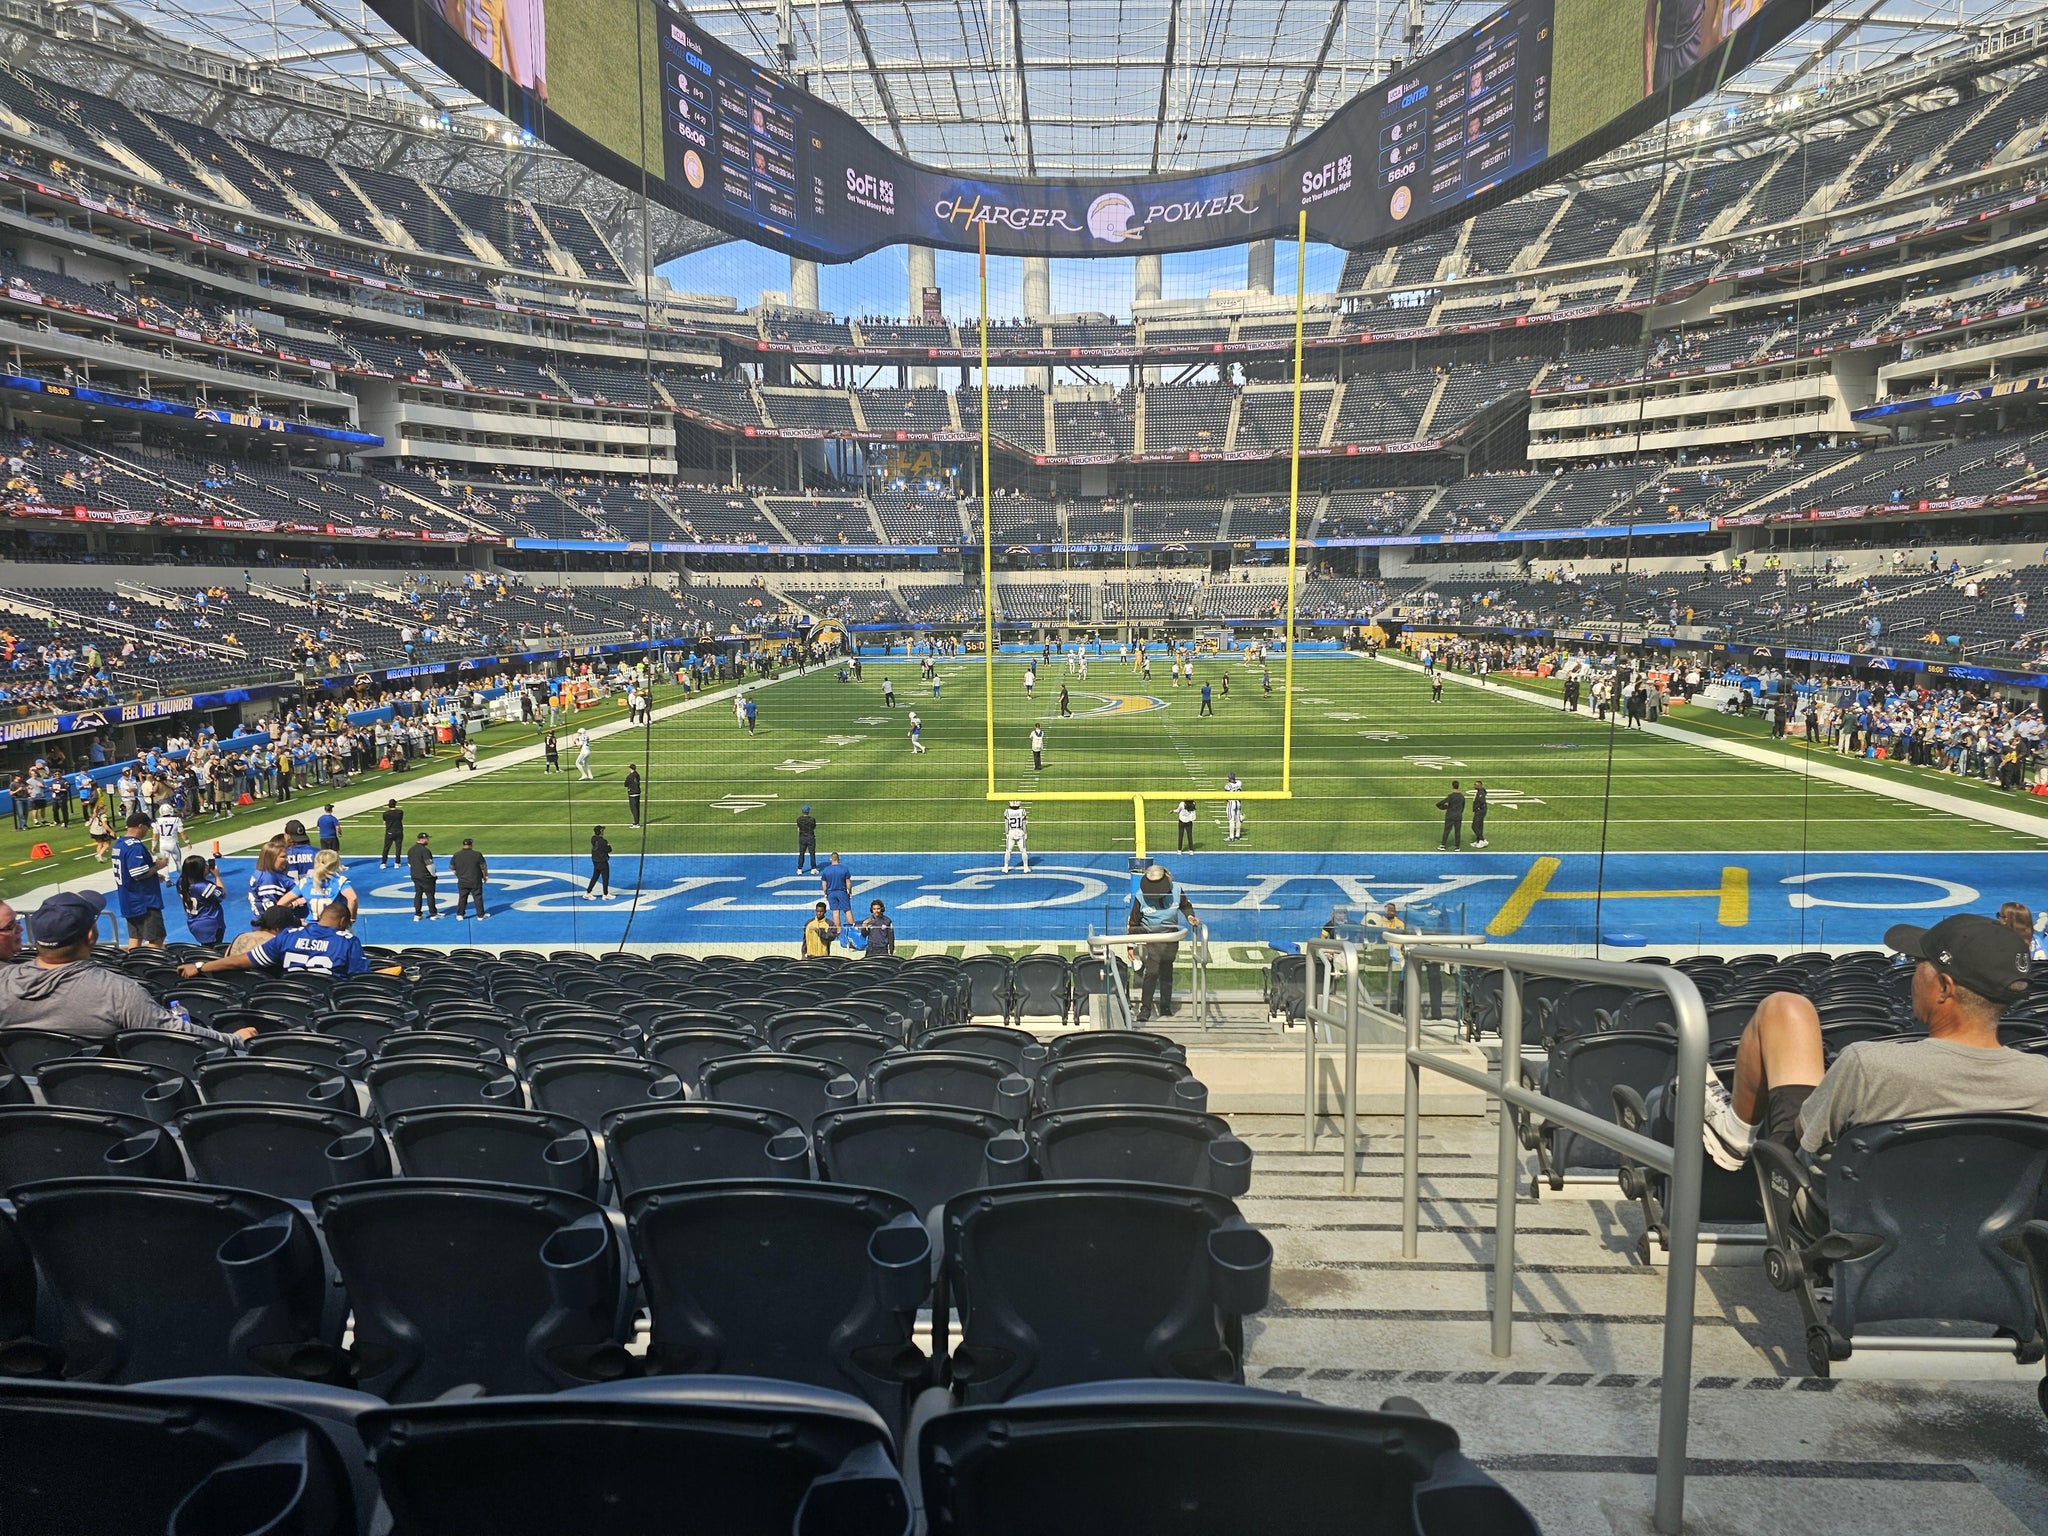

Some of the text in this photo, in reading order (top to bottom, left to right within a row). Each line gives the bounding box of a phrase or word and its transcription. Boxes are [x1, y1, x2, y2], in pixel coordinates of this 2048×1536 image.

[686, 52, 712, 76] CENTER
[1403, 78, 1419, 93] Health
[1401, 84, 1428, 108] CENTER
[846, 168, 877, 200] SoFi
[1302, 161, 1335, 194] SoFi
[1302, 196, 1312, 204] Get
[1312, 193, 1322, 201] Your
[1323, 187, 1338, 198] Money
[866, 200, 881, 212] Money
[934, 194, 1259, 232] CHARGER POWER
[2037, 377, 2048, 390] L
[230, 413, 285, 432] BOLT UP LA
[1389, 440, 1436, 452] TRUCKTOBER
[1072, 455, 1113, 465] TRUCKTOBER
[1785, 648, 1850, 664] WELCOME TO THE STORM
[387, 664, 445, 680] WELCOME TO THE STORM
[122, 697, 193, 720] FEEL THE THUNDER
[4, 718, 59, 742] LIGHTNING
[160, 824, 174, 836] 17
[1009, 817, 1022, 829] 21
[288, 854, 312, 864] CLARK
[295, 937, 329, 952] NELSON
[1770, 1261, 1778, 1278] 12
